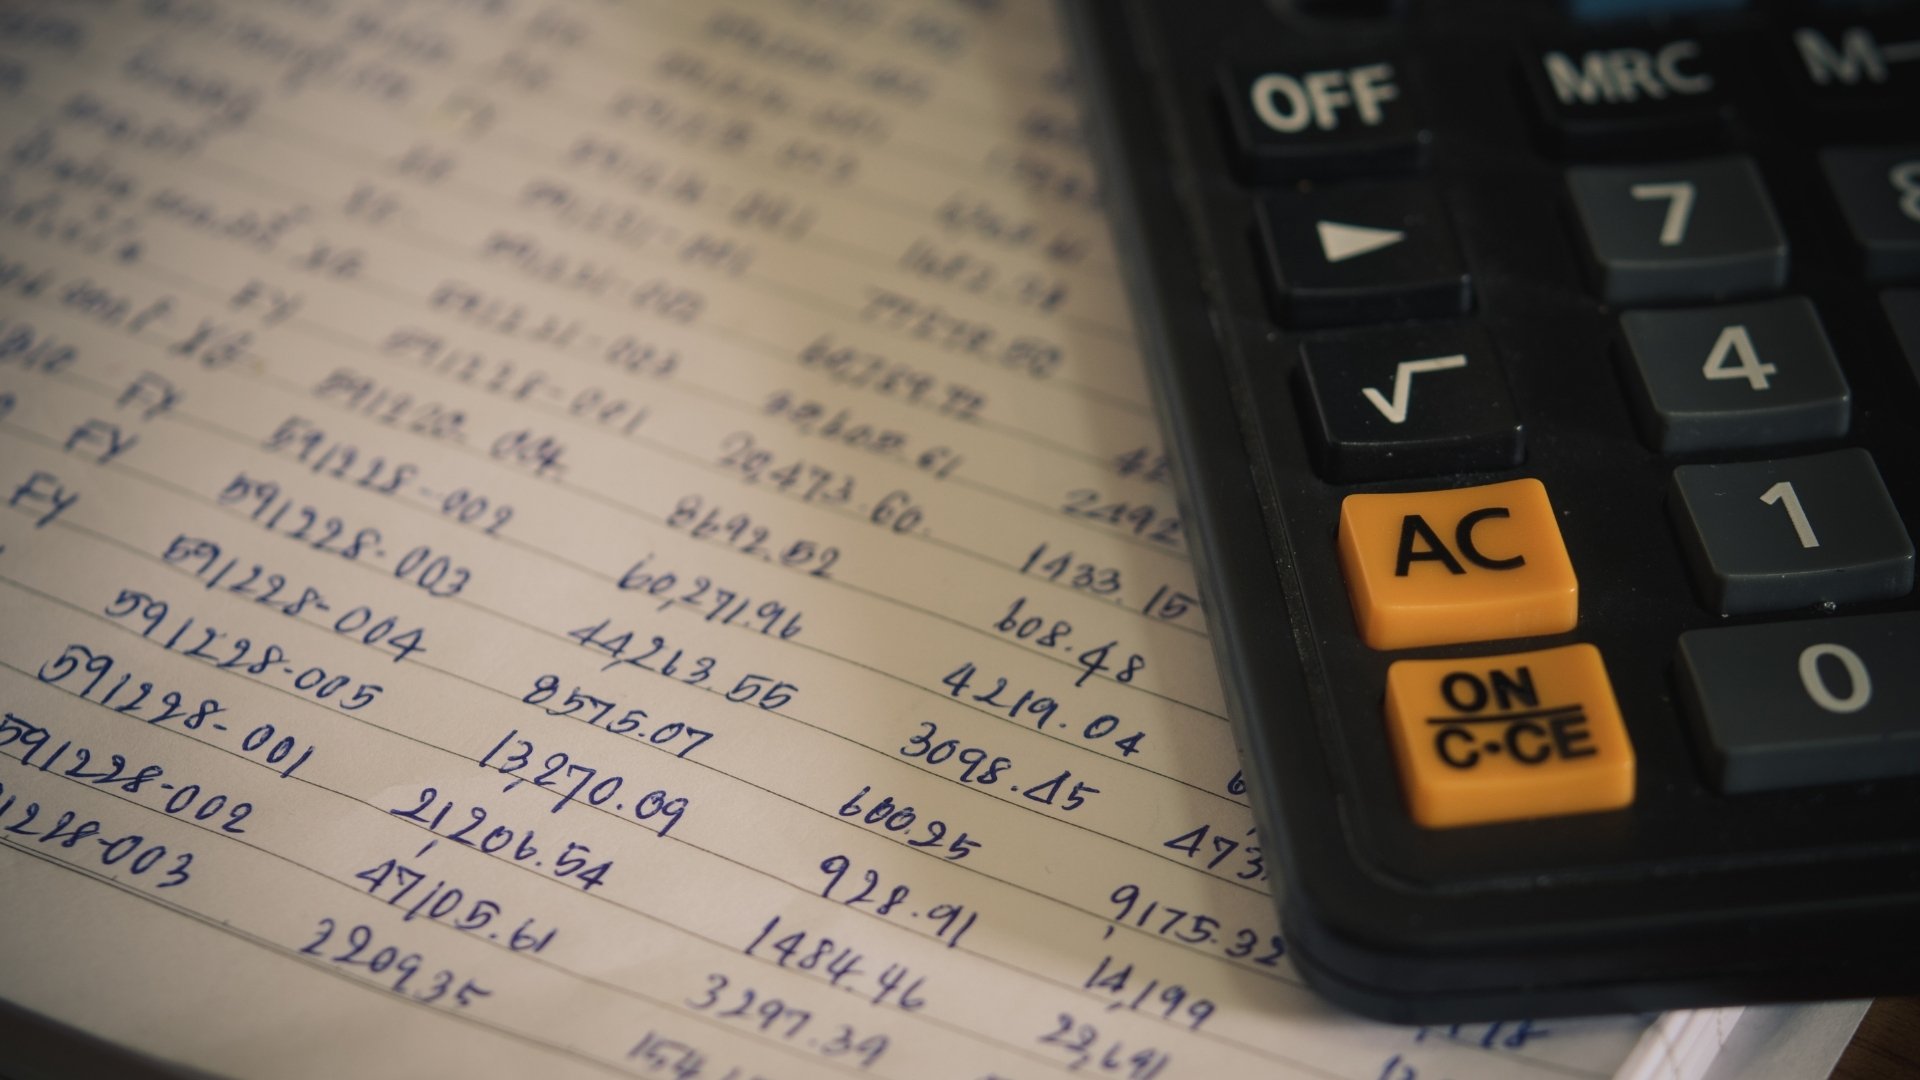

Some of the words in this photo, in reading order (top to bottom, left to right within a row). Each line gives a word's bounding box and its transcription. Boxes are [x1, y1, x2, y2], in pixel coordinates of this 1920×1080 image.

[1251, 64, 1398, 133] OFF
[1544, 41, 1712, 104] MRC
[1631, 182, 1696, 246] 7
[1702, 325, 1777, 390] 4
[9, 470, 80, 528] FY
[1759, 481, 1820, 549] 1
[1394, 507, 1526, 577] AC
[1440, 666, 1540, 712] ON
[1798, 643, 1872, 713] 0
